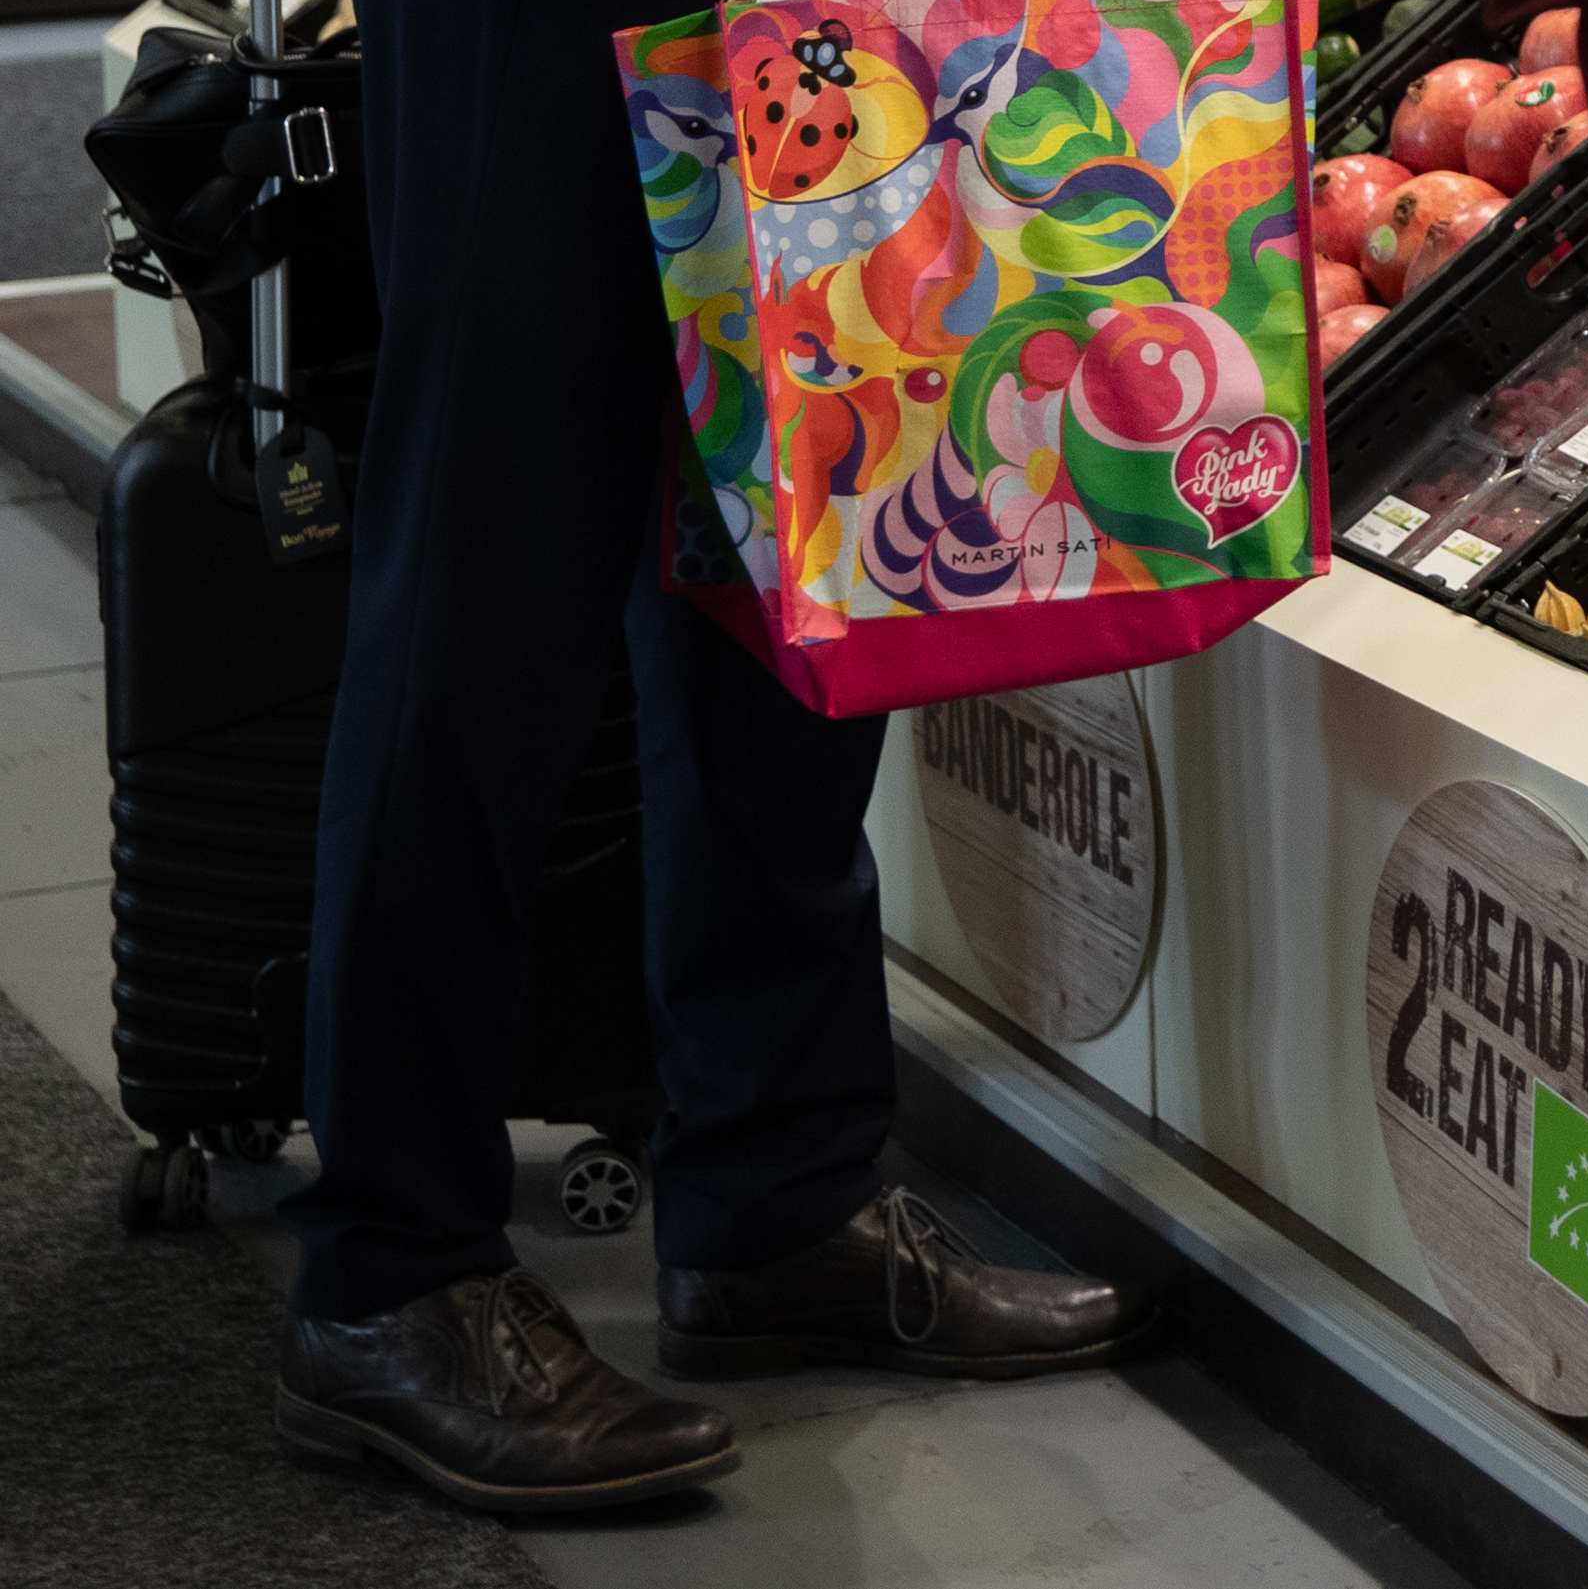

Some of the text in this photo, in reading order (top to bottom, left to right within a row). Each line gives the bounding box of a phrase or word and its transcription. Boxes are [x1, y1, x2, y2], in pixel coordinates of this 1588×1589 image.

[1192, 429, 1268, 495] Pink
[1203, 461, 1280, 515] Lady
[951, 542, 1045, 566] MARTIN
[923, 698, 1134, 887] BANDEROLE
[1387, 892, 1528, 1188] 2 EAT
